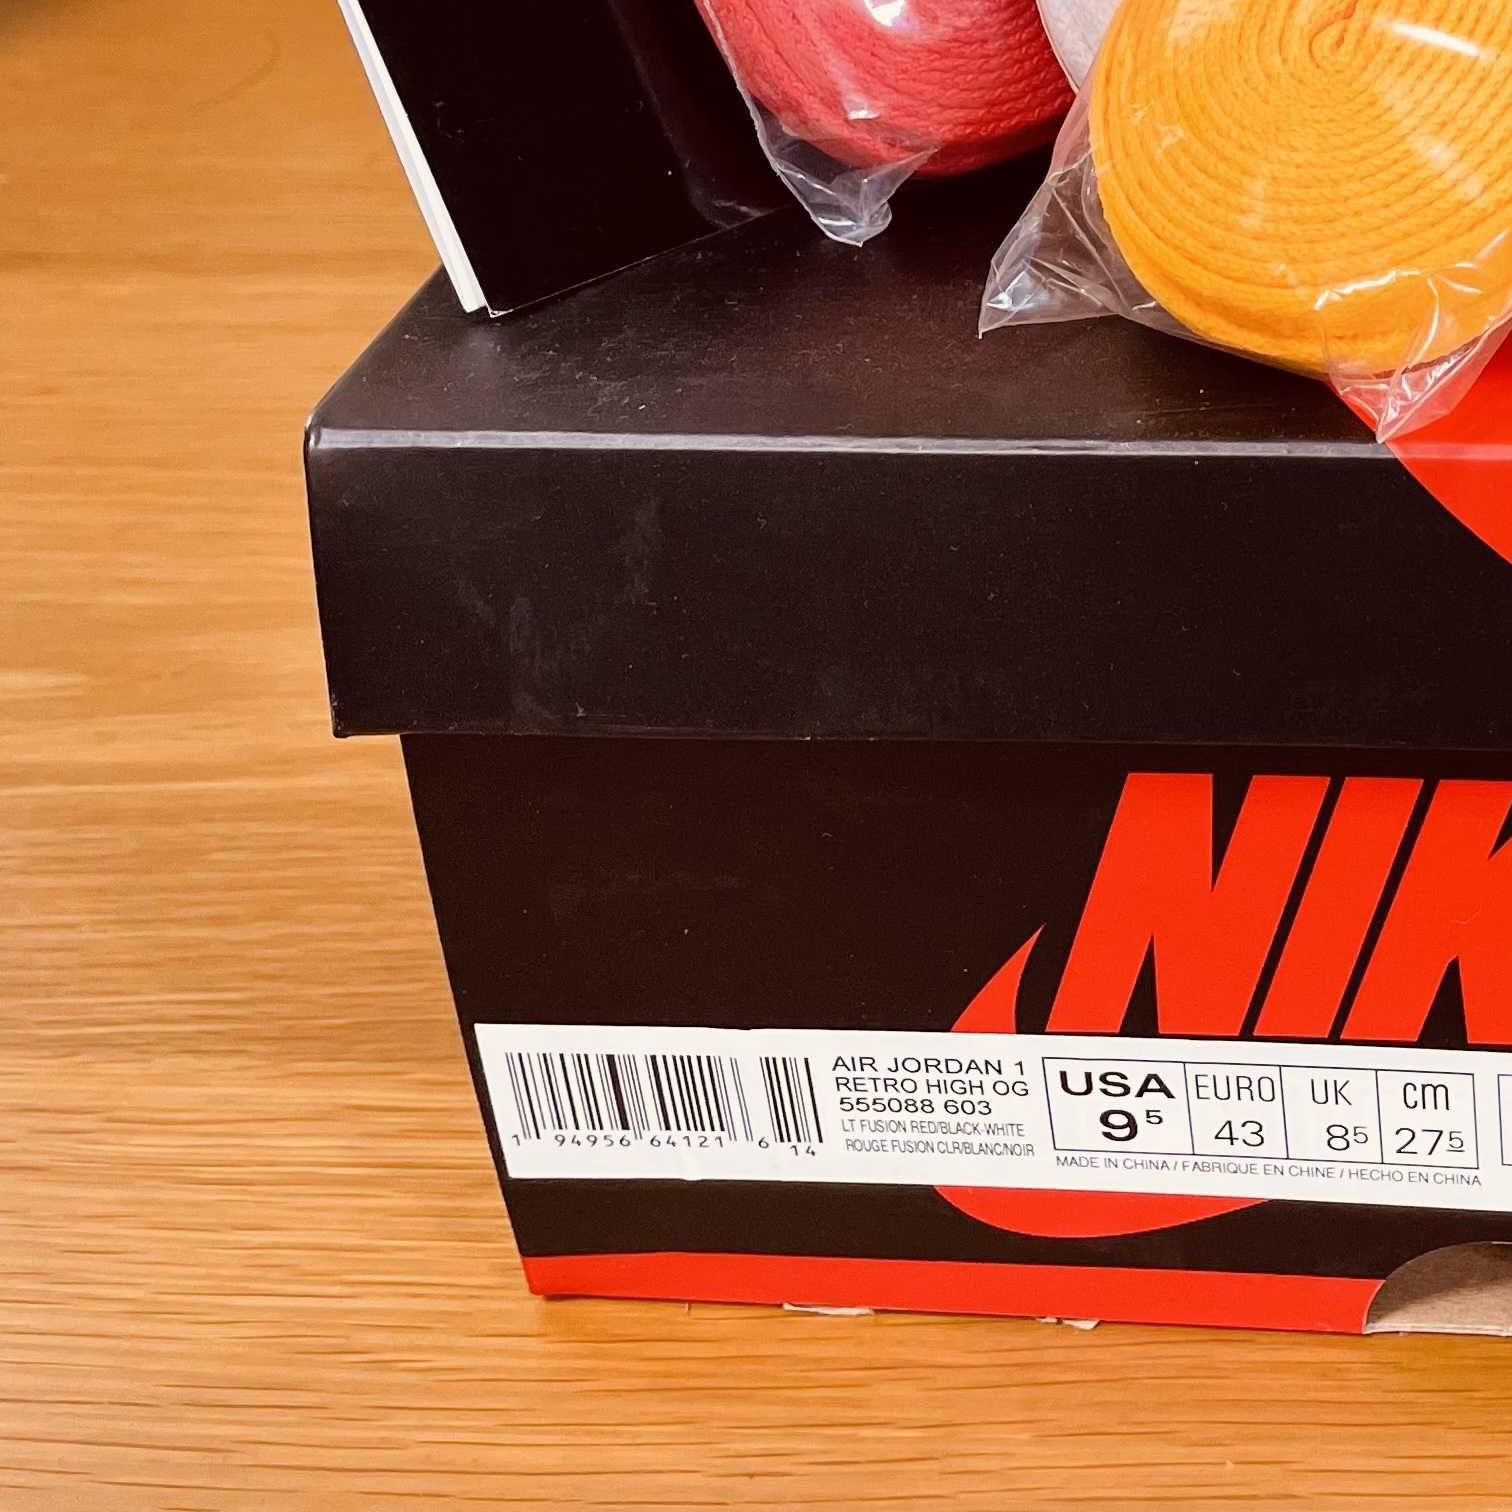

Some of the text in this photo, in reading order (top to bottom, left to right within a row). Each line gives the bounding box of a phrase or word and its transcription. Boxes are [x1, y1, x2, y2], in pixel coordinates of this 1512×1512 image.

[832, 1056, 1025, 1076] AIR JORDAN 1
[835, 1076, 1030, 1097] RETRO HIGH OG
[1059, 1070, 1176, 1099] USA
[1194, 1074, 1276, 1103] EURO
[1311, 1078, 1352, 1106] UK
[839, 1097, 993, 1116] 555088 603
[841, 1119, 856, 1133] LT
[860, 1119, 907, 1134] FUSION
[1214, 1120, 1265, 1148] 43
[845, 1138, 887, 1153] ROUGE
[891, 1139, 935, 1154] FUSION
[1056, 1155, 1100, 1169] MADE
[1104, 1157, 1119, 1169] IN
[1122, 1158, 1170, 1172] CHINA
[1263, 1164, 1285, 1177] EN
[1288, 1165, 1338, 1179] CHINE
[1348, 1167, 1404, 1182] HECHO
[1408, 1171, 1428, 1184] EN
[1432, 1172, 1483, 1186] CHINA
